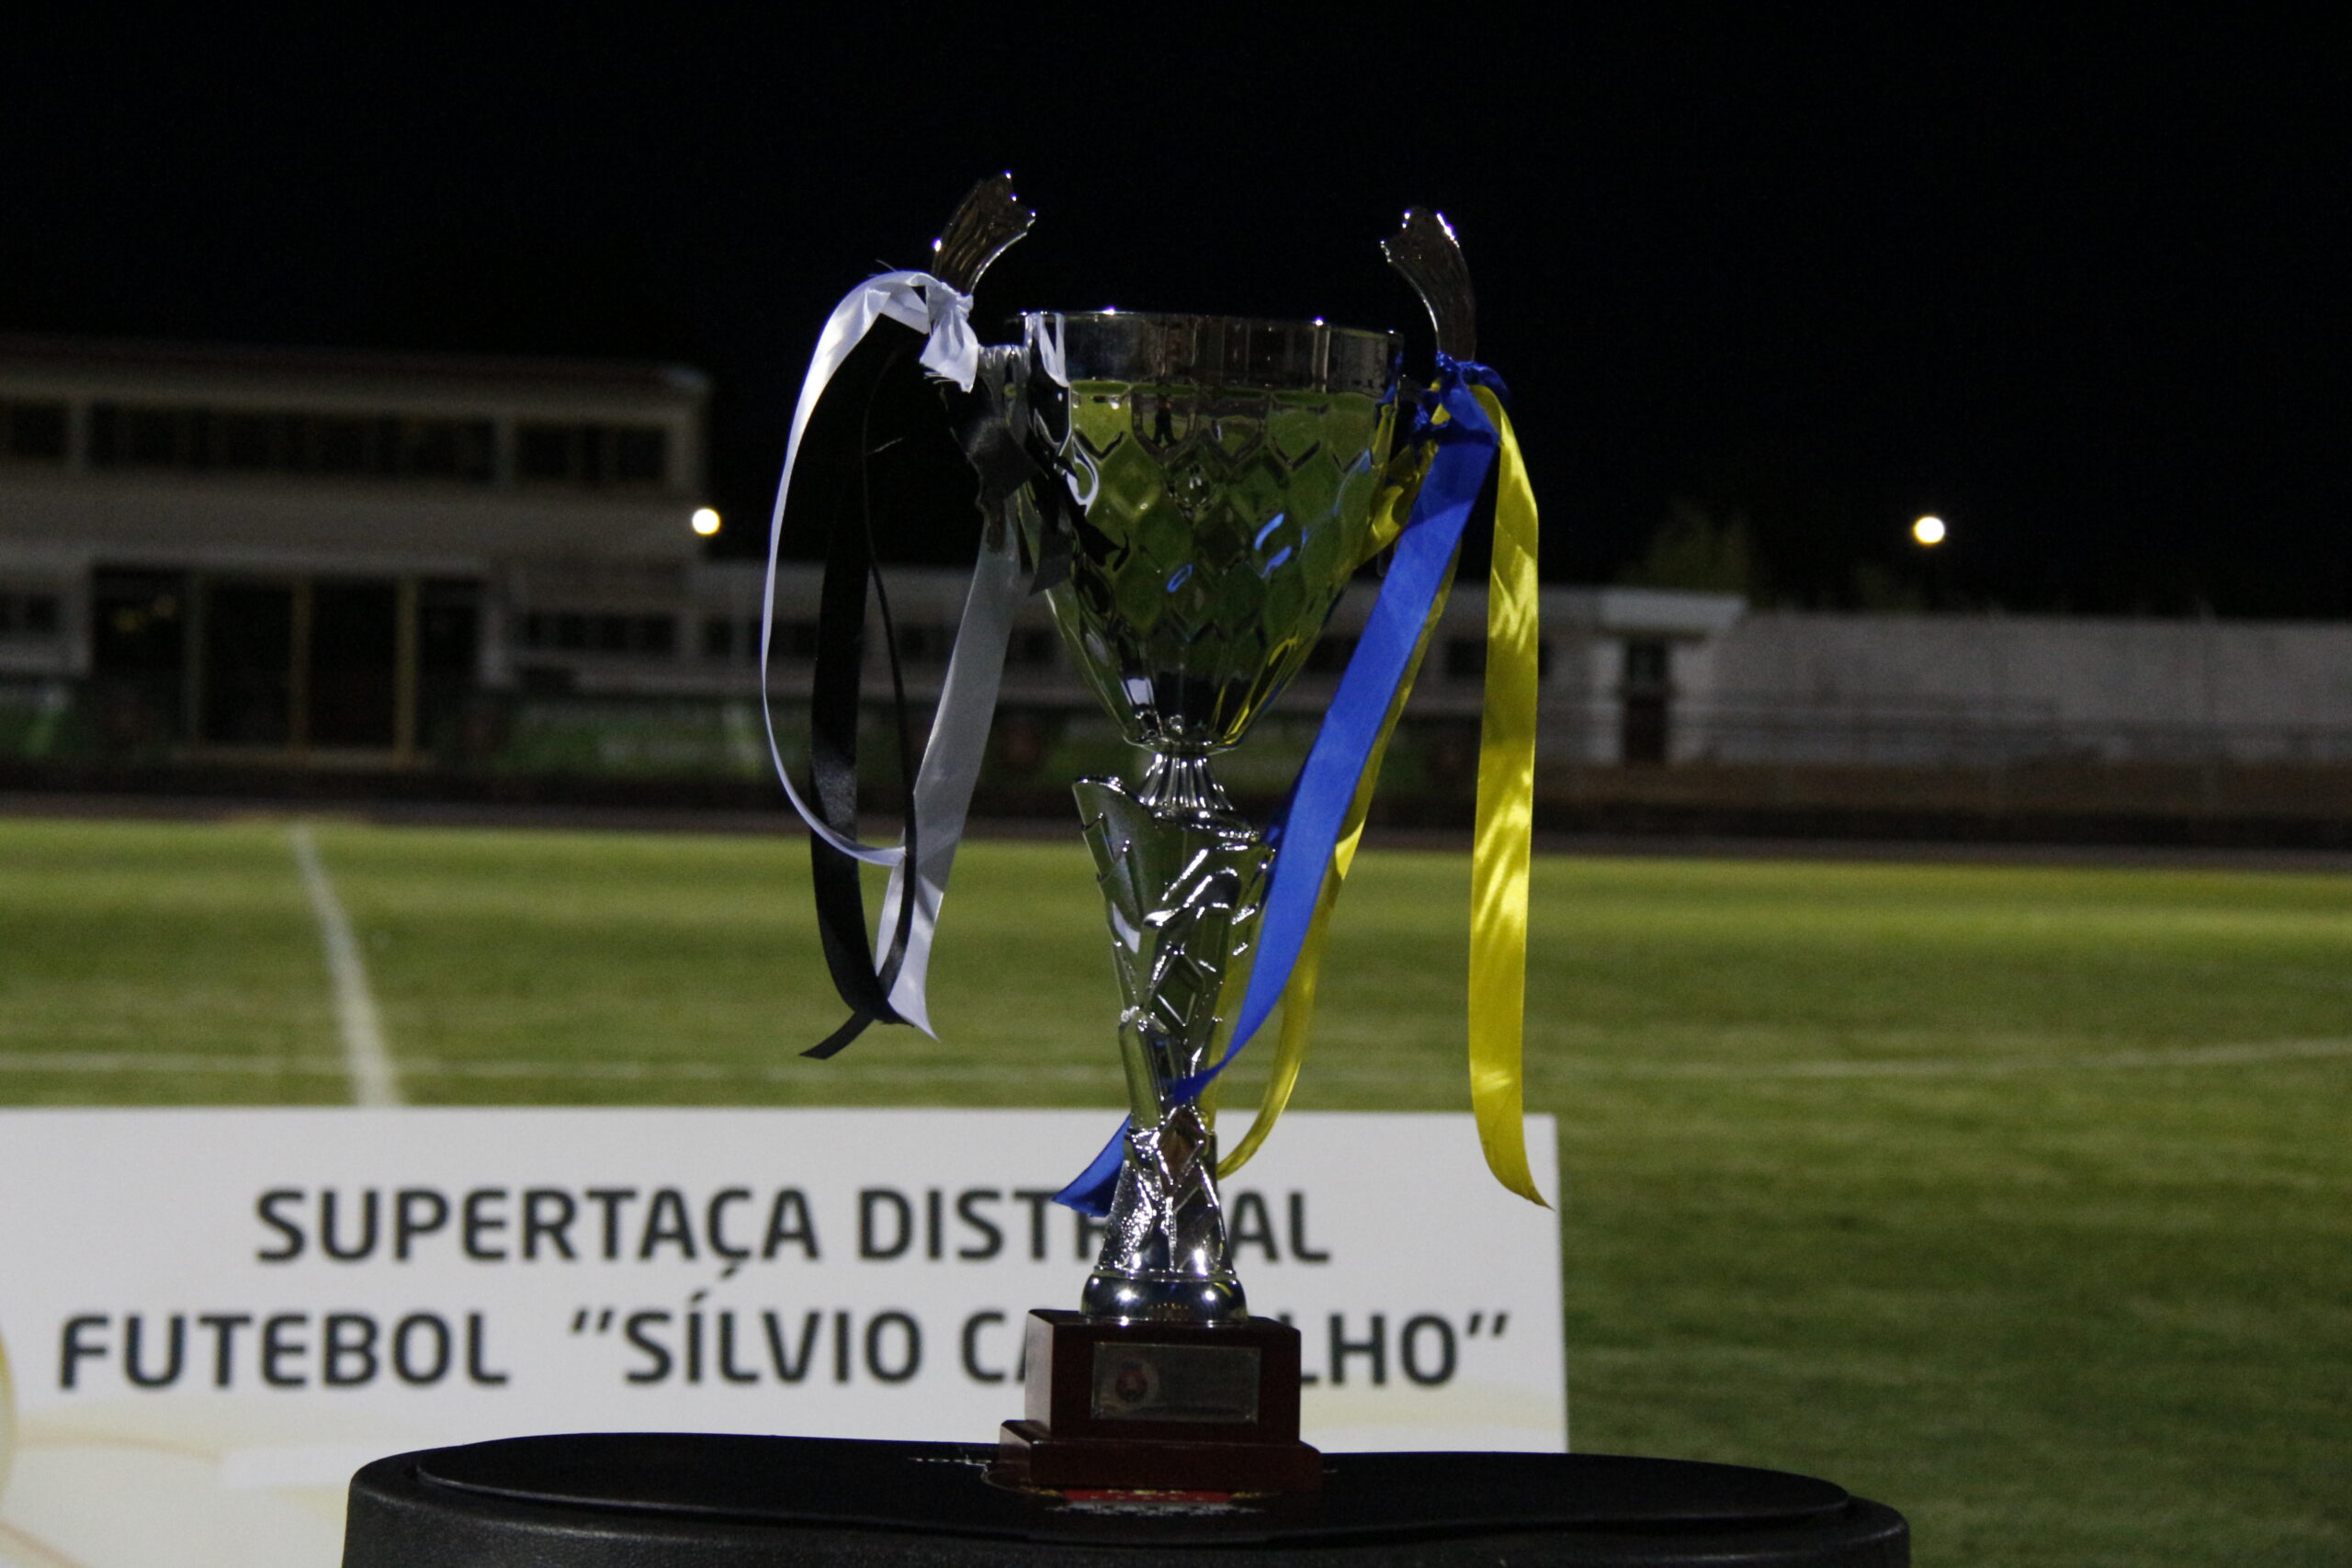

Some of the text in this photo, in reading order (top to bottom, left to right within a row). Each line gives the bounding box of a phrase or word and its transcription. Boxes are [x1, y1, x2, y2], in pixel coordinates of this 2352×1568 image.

[254, 1186, 1331, 1281] SUPERTAÇA DISTAL
[58, 1312, 510, 1390] FUTEBOL
[569, 1289, 923, 1386] "SÍLVIO
